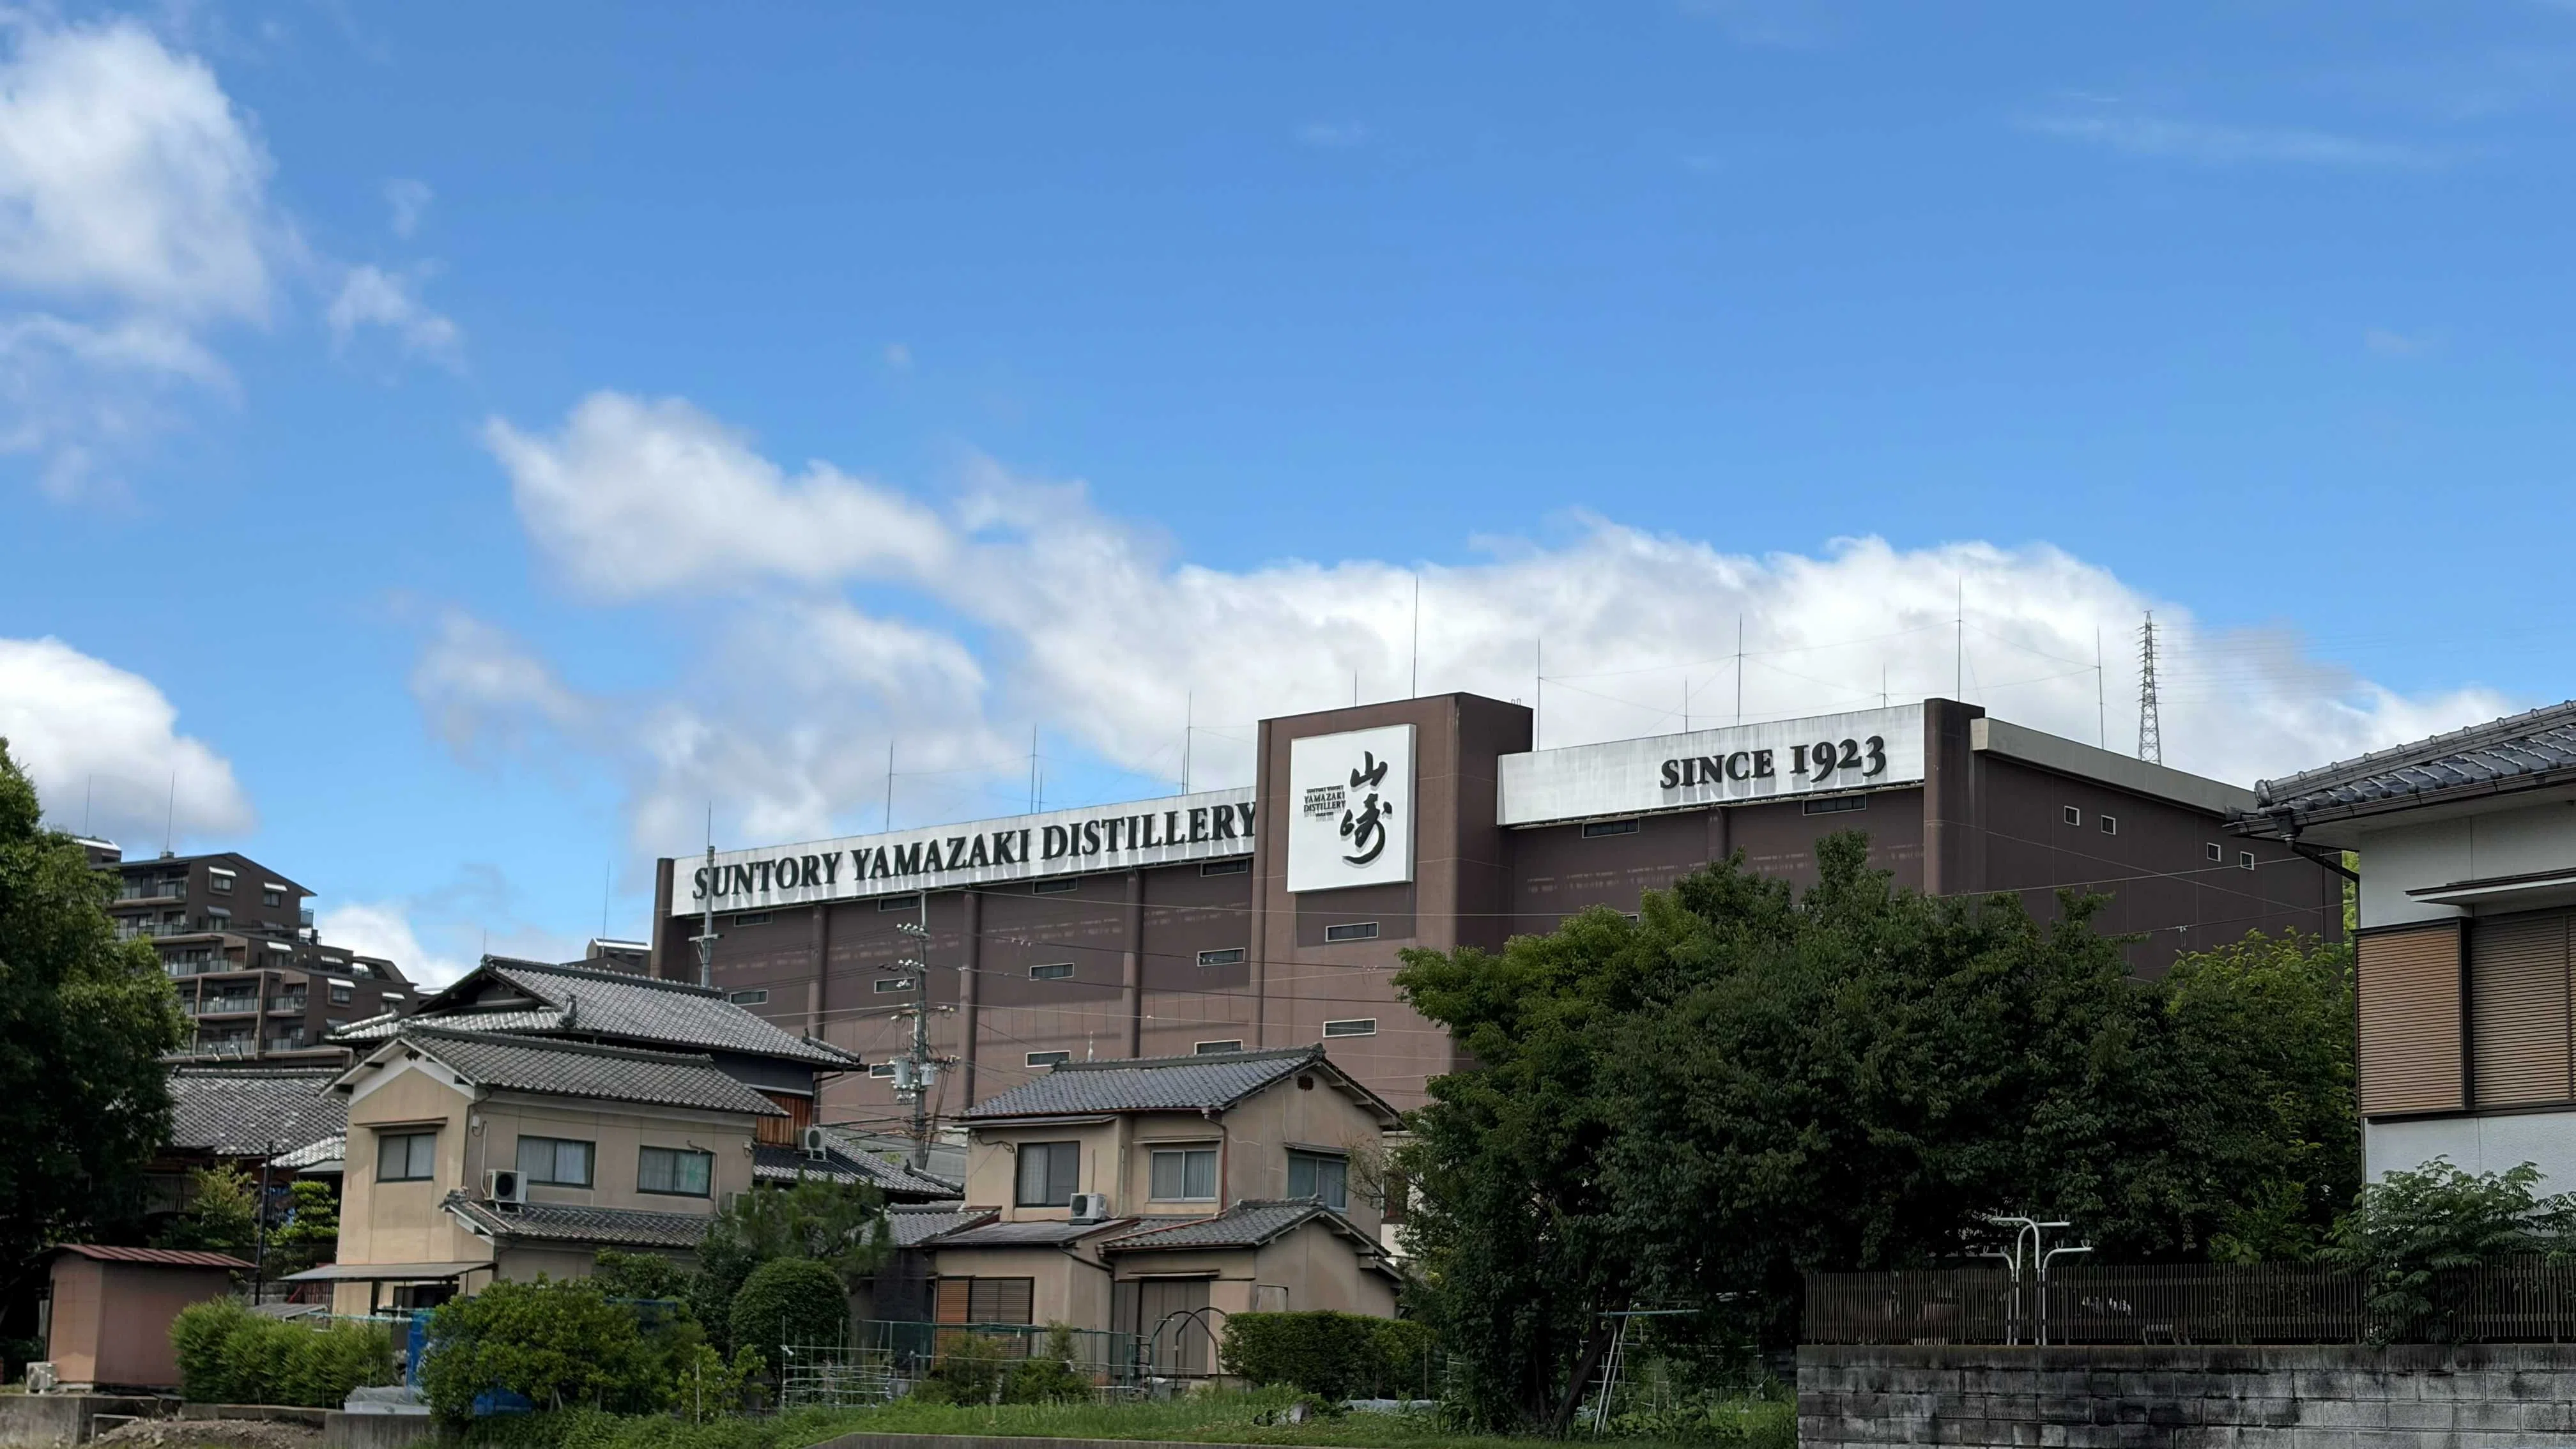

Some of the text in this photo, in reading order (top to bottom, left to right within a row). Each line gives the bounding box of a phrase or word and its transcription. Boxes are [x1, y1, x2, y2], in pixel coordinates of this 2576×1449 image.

[1660, 735, 1886, 789] SINCE 1923
[1303, 800, 1346, 813] DISTILLERY
[1304, 792, 1345, 804] YAMAZAKI
[693, 802, 1256, 900] SUNTORY YAMAZAKI DISTILLERY
